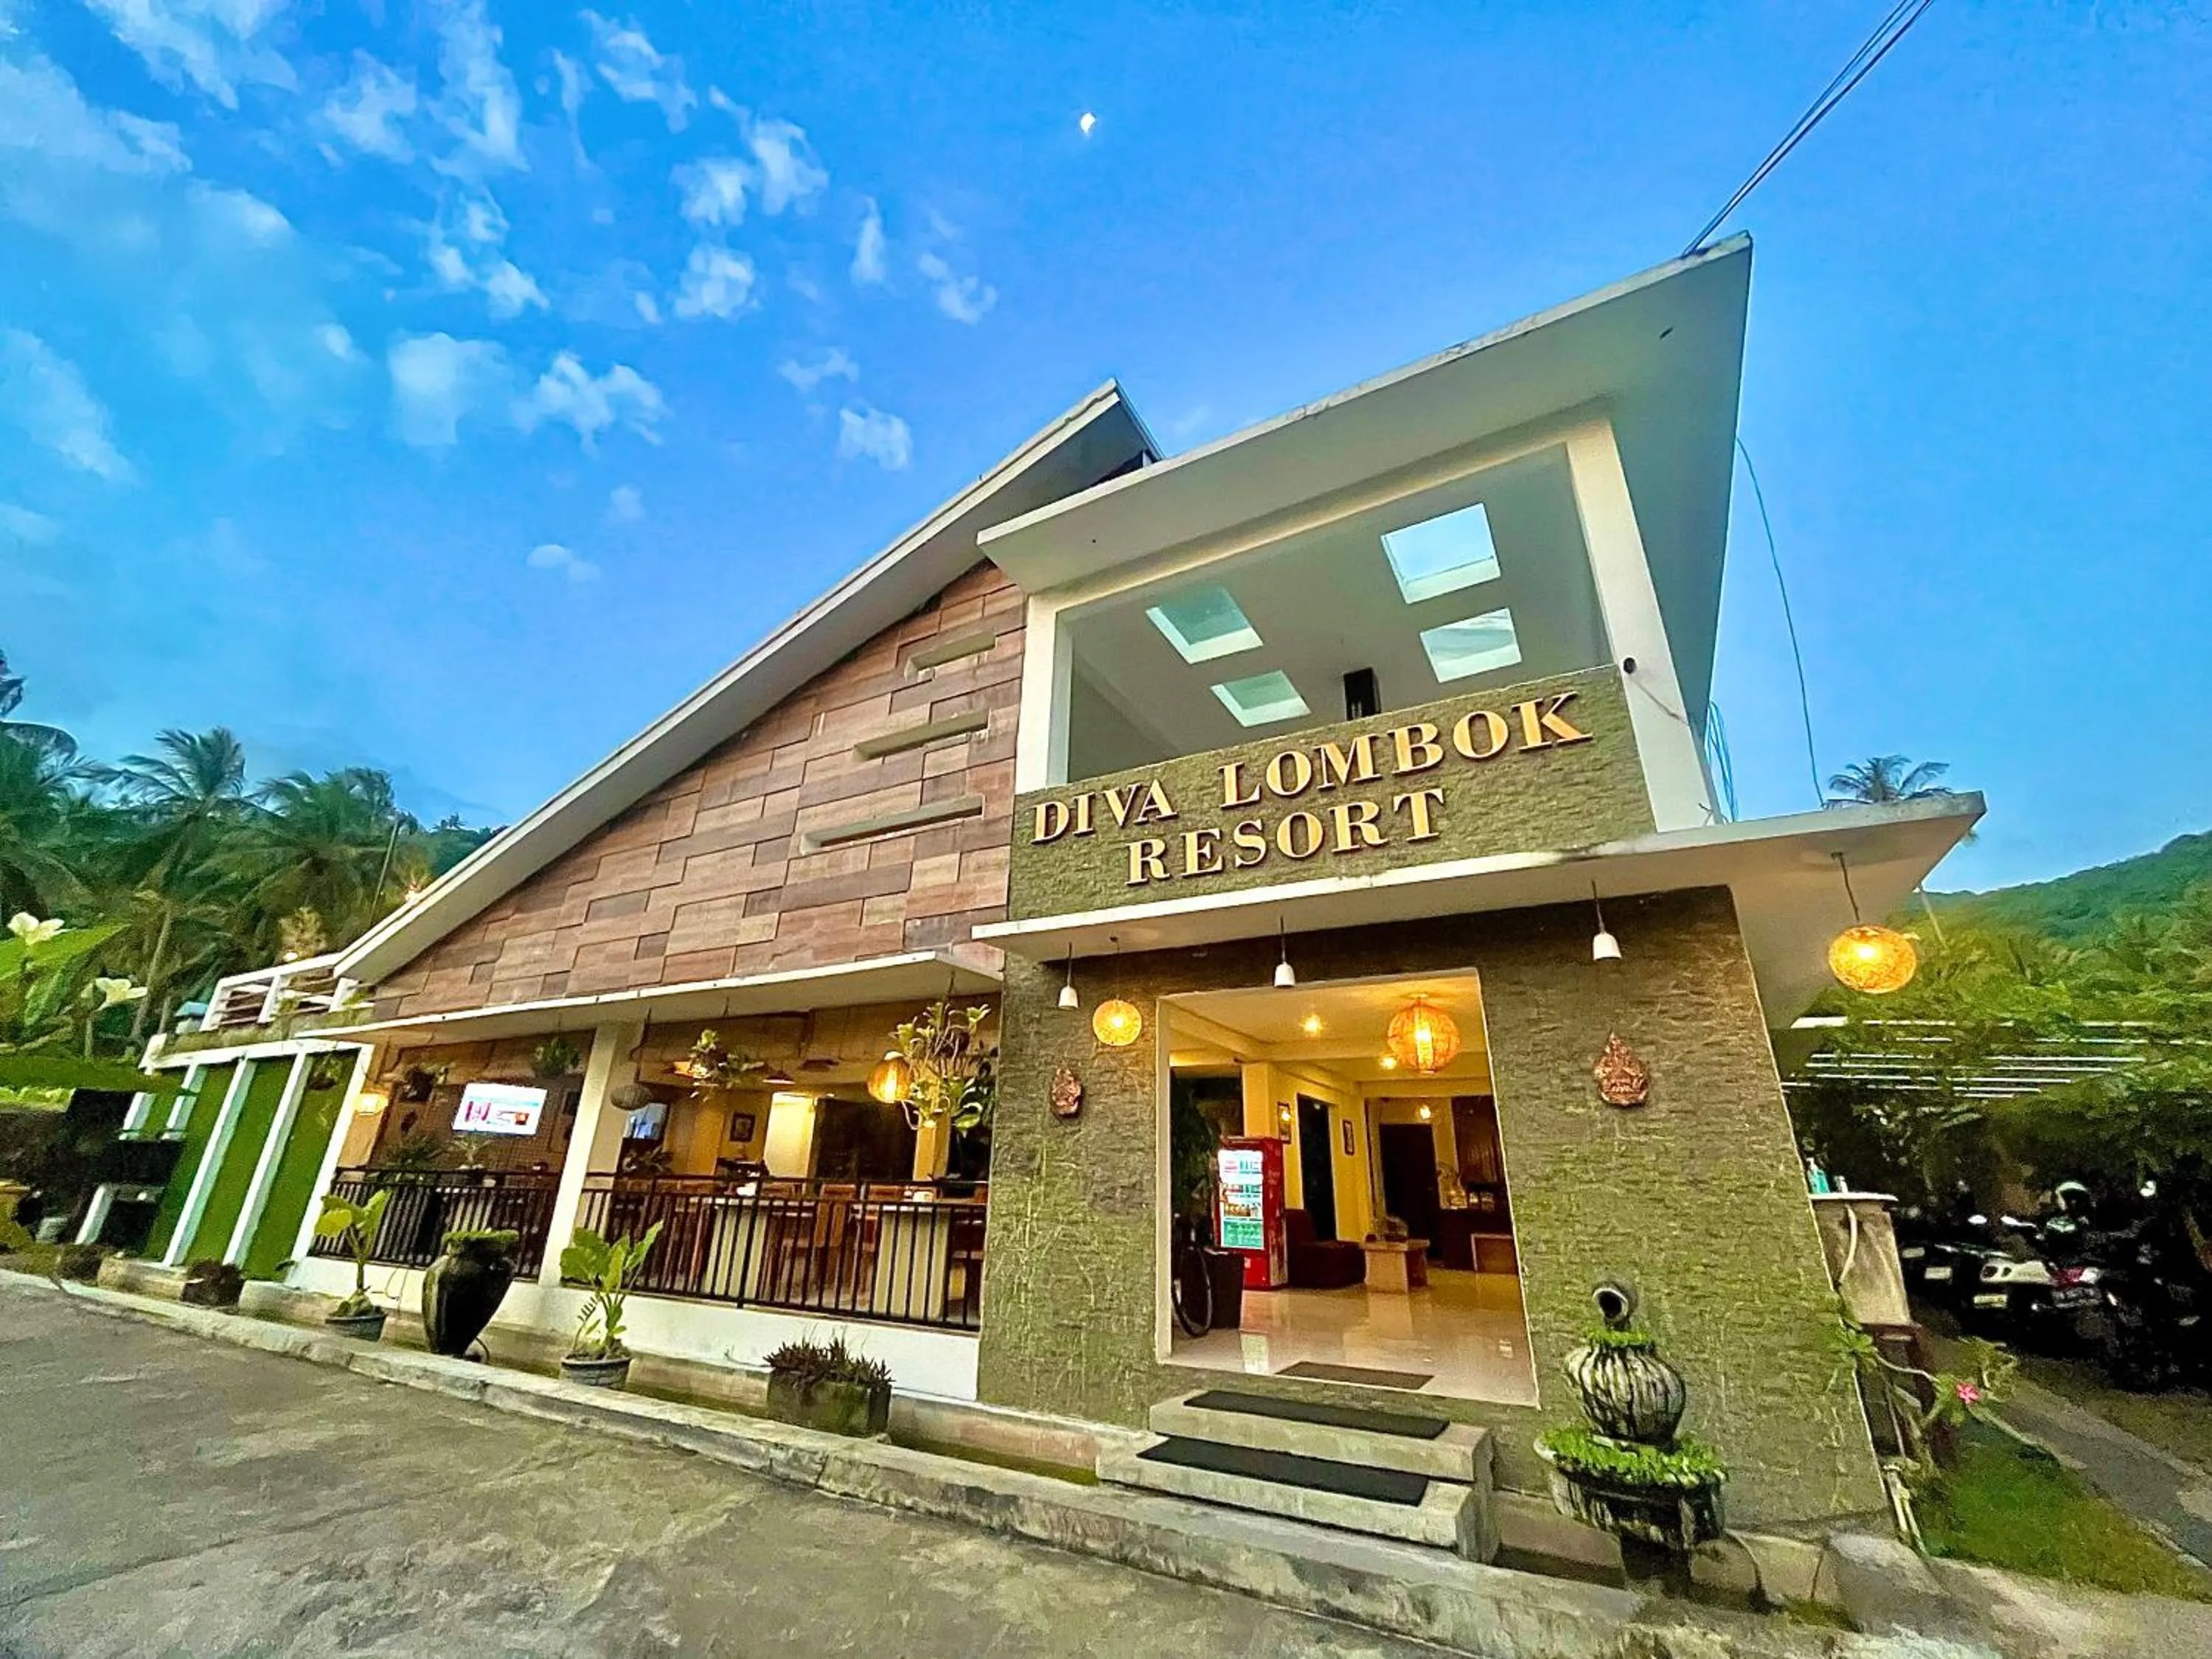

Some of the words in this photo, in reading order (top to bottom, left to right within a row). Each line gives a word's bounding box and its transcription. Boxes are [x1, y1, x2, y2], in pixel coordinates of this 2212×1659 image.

[1031, 778, 1178, 844] DIVA
[1218, 691, 1593, 809] LOMBOK
[1124, 788, 1444, 885] RESORT
